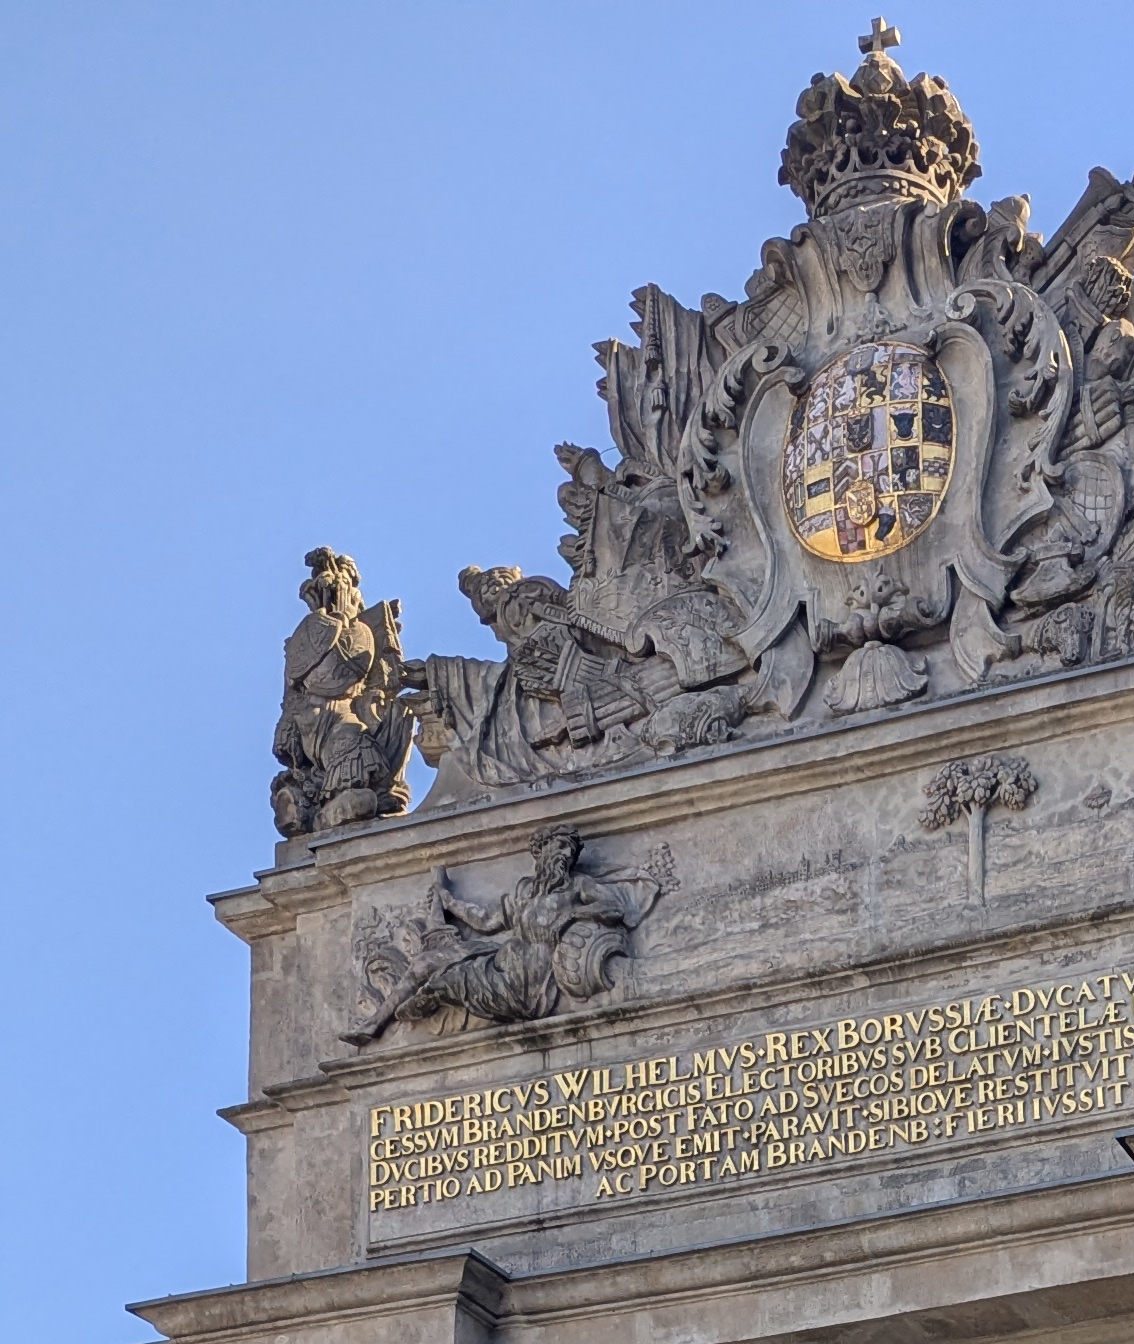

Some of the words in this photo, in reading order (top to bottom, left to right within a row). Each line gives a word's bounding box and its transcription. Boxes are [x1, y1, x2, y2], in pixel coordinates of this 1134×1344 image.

[370, 1127, 459, 1161] CESSVM
[706, 1047, 886, 1100] ELECTORIBVS
[892, 1036, 942, 1066] SVB
[948, 1000, 1126, 1054] CLIENTELÆ
[370, 1081, 550, 1137] FRIDERICVS
[370, 1150, 469, 1186] DVCIBVS
[613, 1111, 682, 1143] POST
[687, 1098, 753, 1130] FATO
[760, 1090, 798, 1117] AD
[803, 1070, 904, 1108] SVECOS
[370, 1178, 460, 1212] PERTIO
[466, 1169, 502, 1195] AD
[507, 1155, 581, 1187] PANIM
[589, 1140, 670, 1172] VSQVE
[595, 1172, 632, 1197] AC
[639, 1149, 760, 1190] PORTAM
